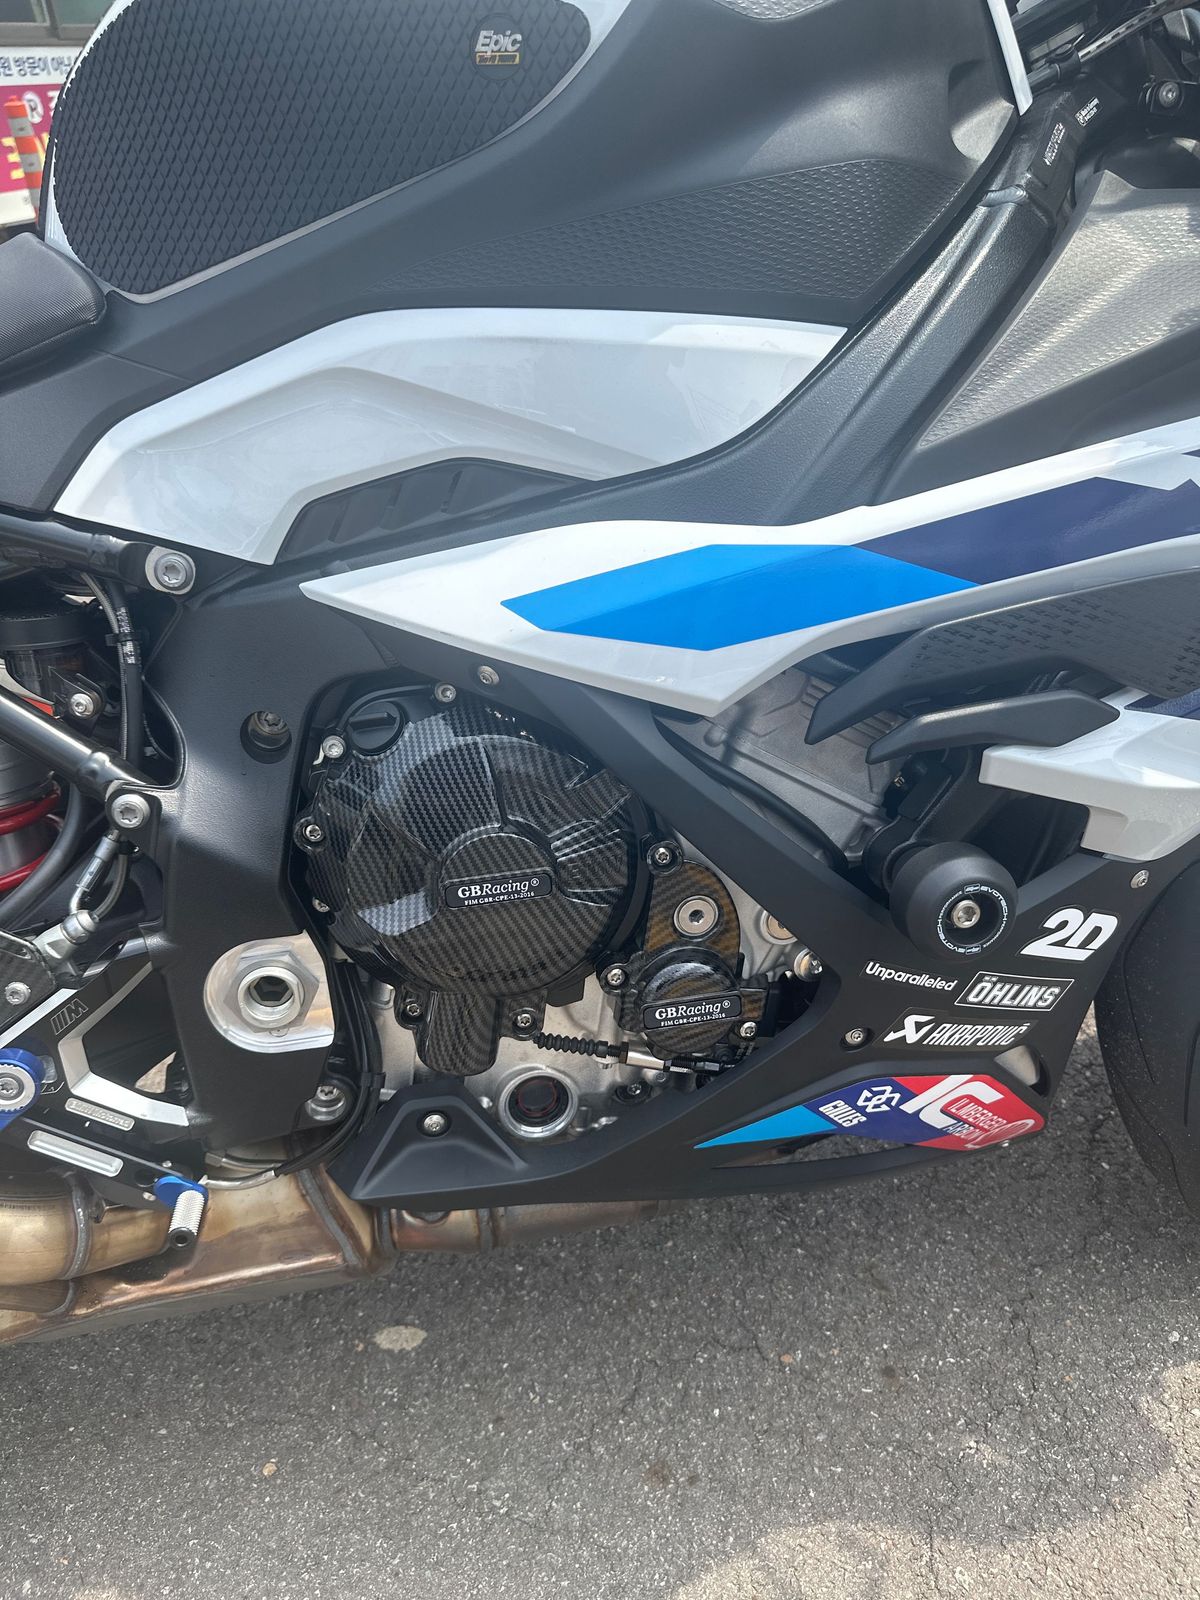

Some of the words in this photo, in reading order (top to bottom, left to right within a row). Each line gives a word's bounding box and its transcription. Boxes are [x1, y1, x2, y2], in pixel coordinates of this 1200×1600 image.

[475, 30, 522, 57] Epic
[1020, 908, 1119, 961] 2D
[865, 961, 959, 991] Unparalleled
[967, 975, 1062, 1008] ÖHLINS
[818, 1099, 867, 1128] GILLES
